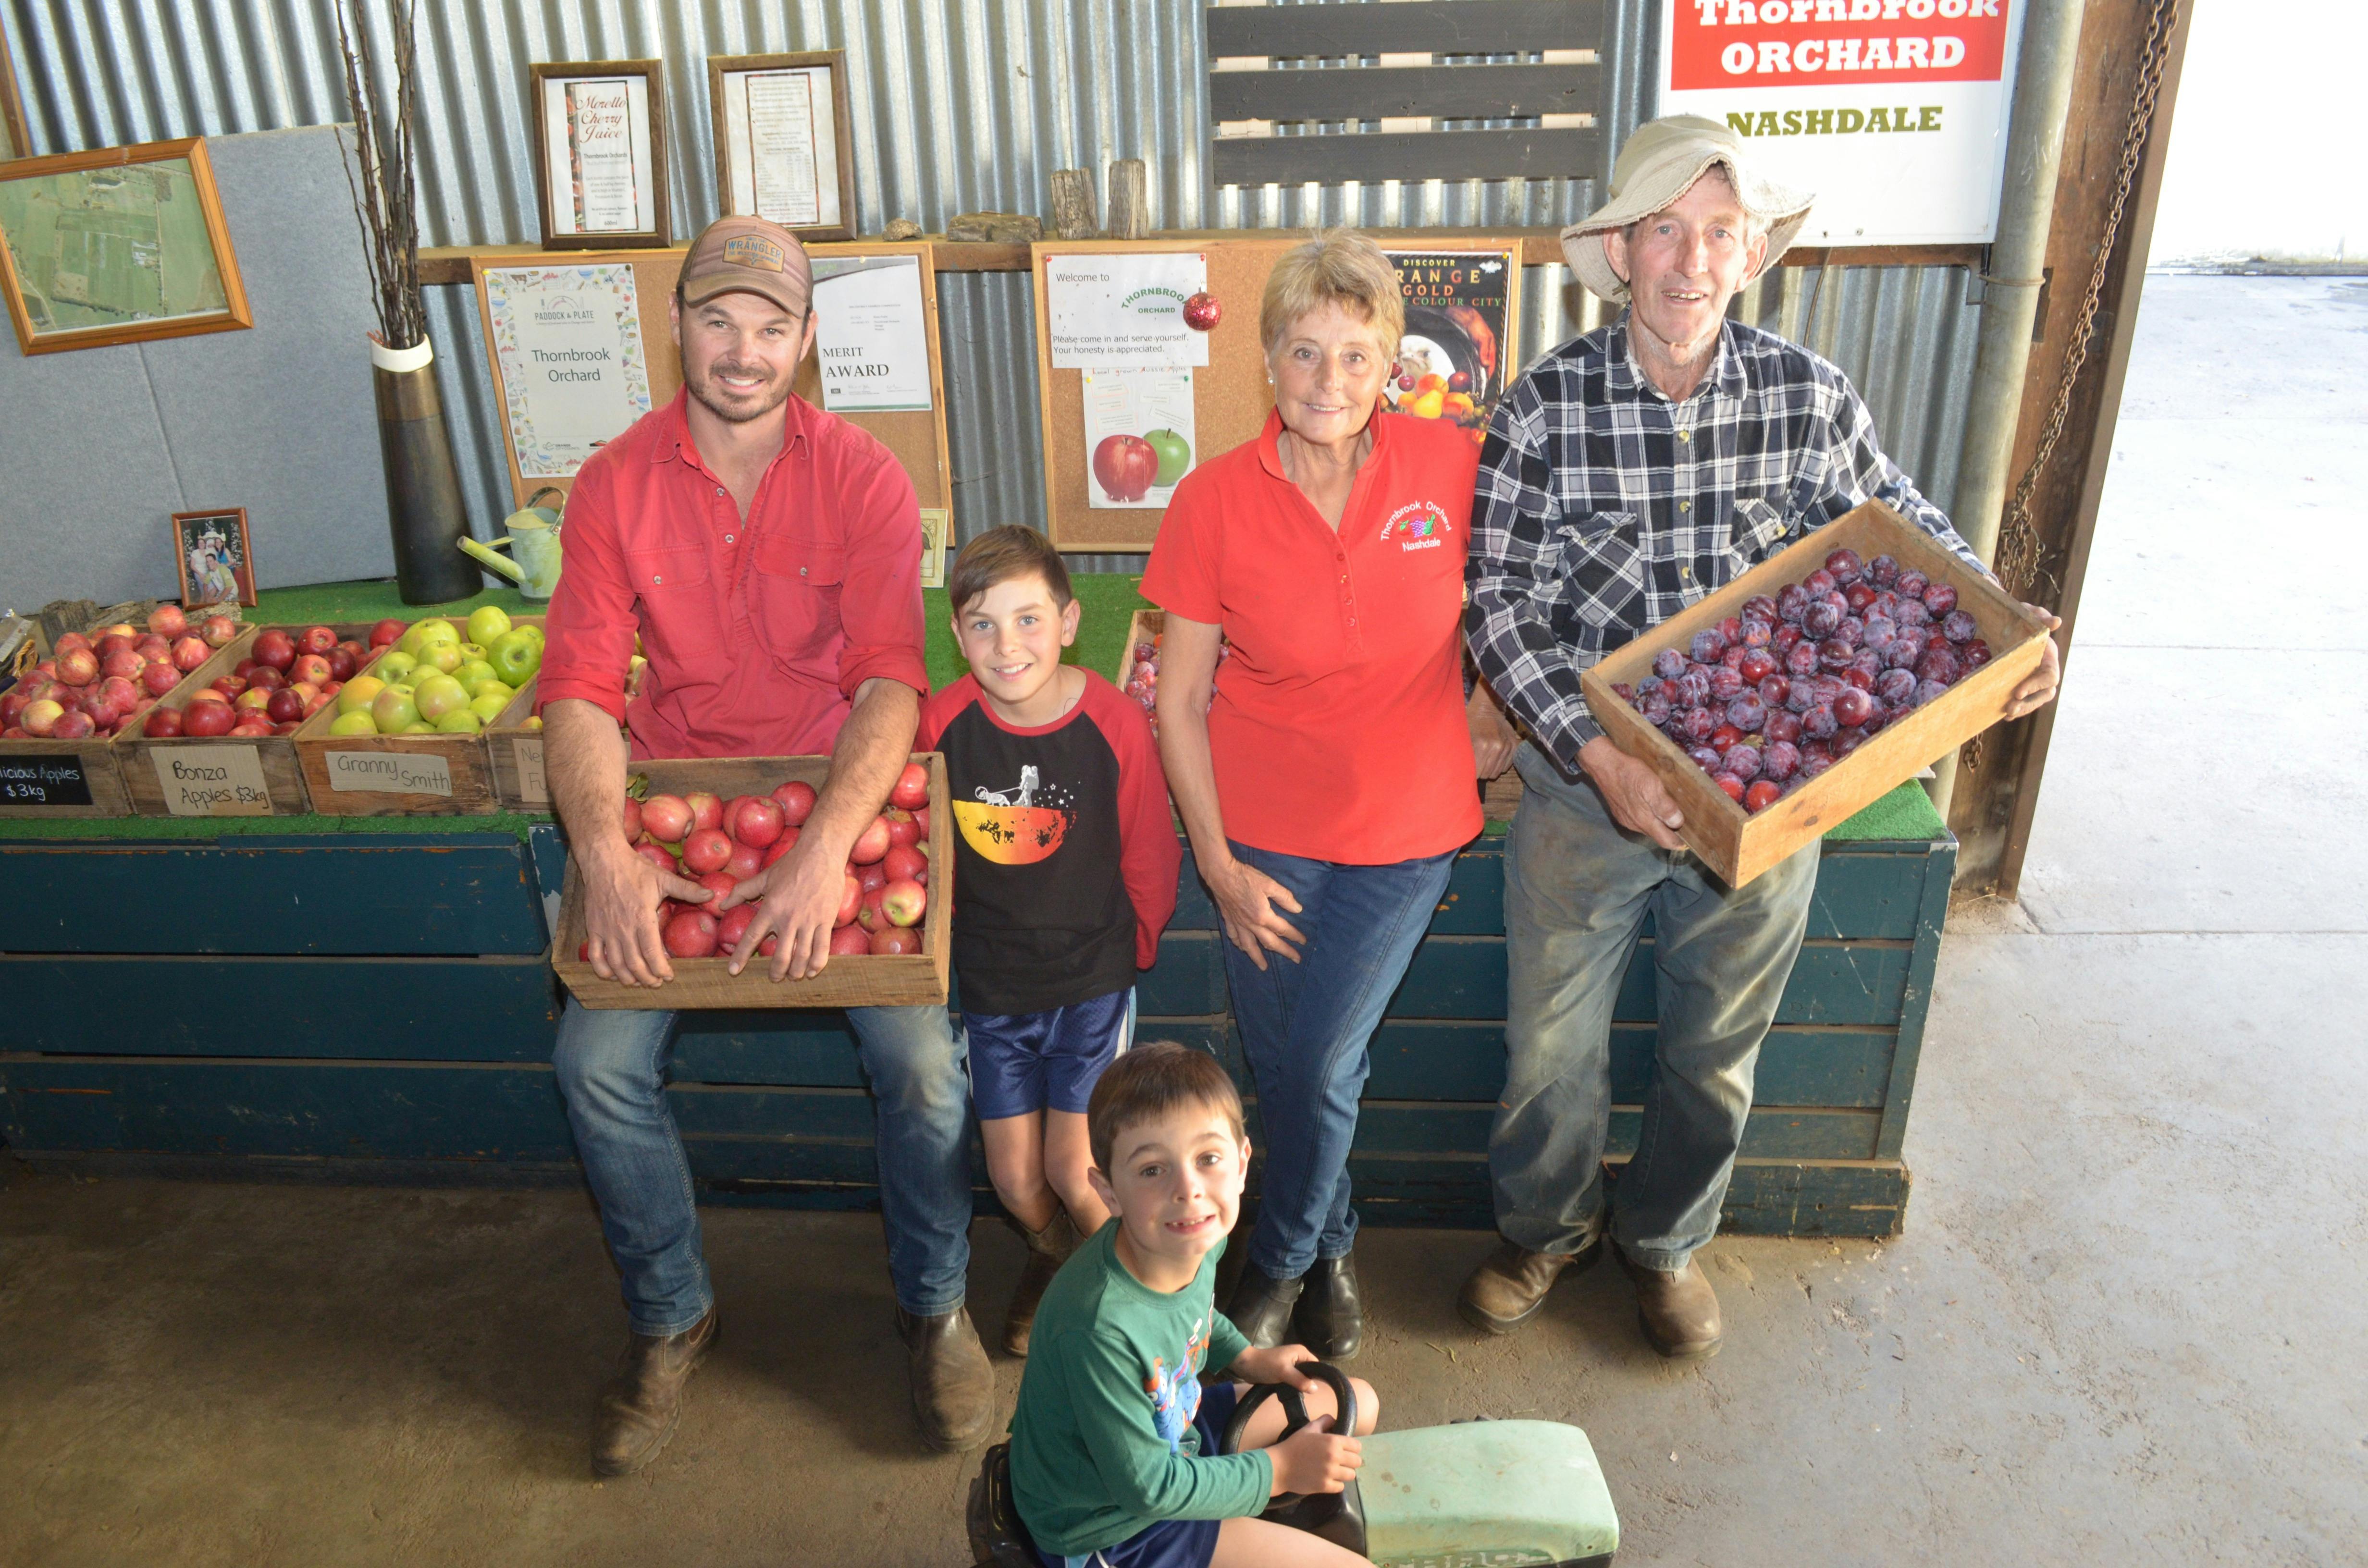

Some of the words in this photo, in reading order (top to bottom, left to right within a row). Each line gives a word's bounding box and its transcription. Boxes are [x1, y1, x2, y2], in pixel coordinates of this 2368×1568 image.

[1695, 0, 1998, 26] Thornbrook
[1721, 36, 1965, 74] ORCHARD
[575, 96, 626, 110] Morello
[581, 110, 622, 127] Cherry
[1727, 106, 1943, 137] NASHDALE
[580, 125, 622, 143] Juice
[728, 241, 781, 258] WRANGLER
[1056, 273, 1097, 282] Welcome
[1394, 269, 1480, 283] RANGE
[1403, 284, 1454, 296] GOLD
[1412, 297, 1464, 306] COLOUR
[1471, 297, 1502, 307] CITY
[535, 311, 565, 320] PADDOCK
[574, 310, 594, 319] PLATE
[1155, 334, 1189, 344] yourself.
[531, 347, 611, 362] Thornbrook
[823, 347, 863, 358] MERIT
[1074, 345, 1104, 355] honesty
[1116, 345, 1165, 355] appreciated.
[548, 368, 601, 382] Orchard
[826, 364, 889, 378] AWARD
[1381, 500, 1422, 541] Thornbrook
[1426, 501, 1452, 532] Orchard
[1402, 537, 1441, 552] Nashdale
[0, 766, 37, 779] licious
[40, 764, 80, 785] Apples
[173, 760, 228, 781] Bonza
[338, 755, 398, 781] Granny
[401, 770, 451, 791] Smith
[182, 787, 232, 809] Apples
[235, 784, 270, 809] $3kg
